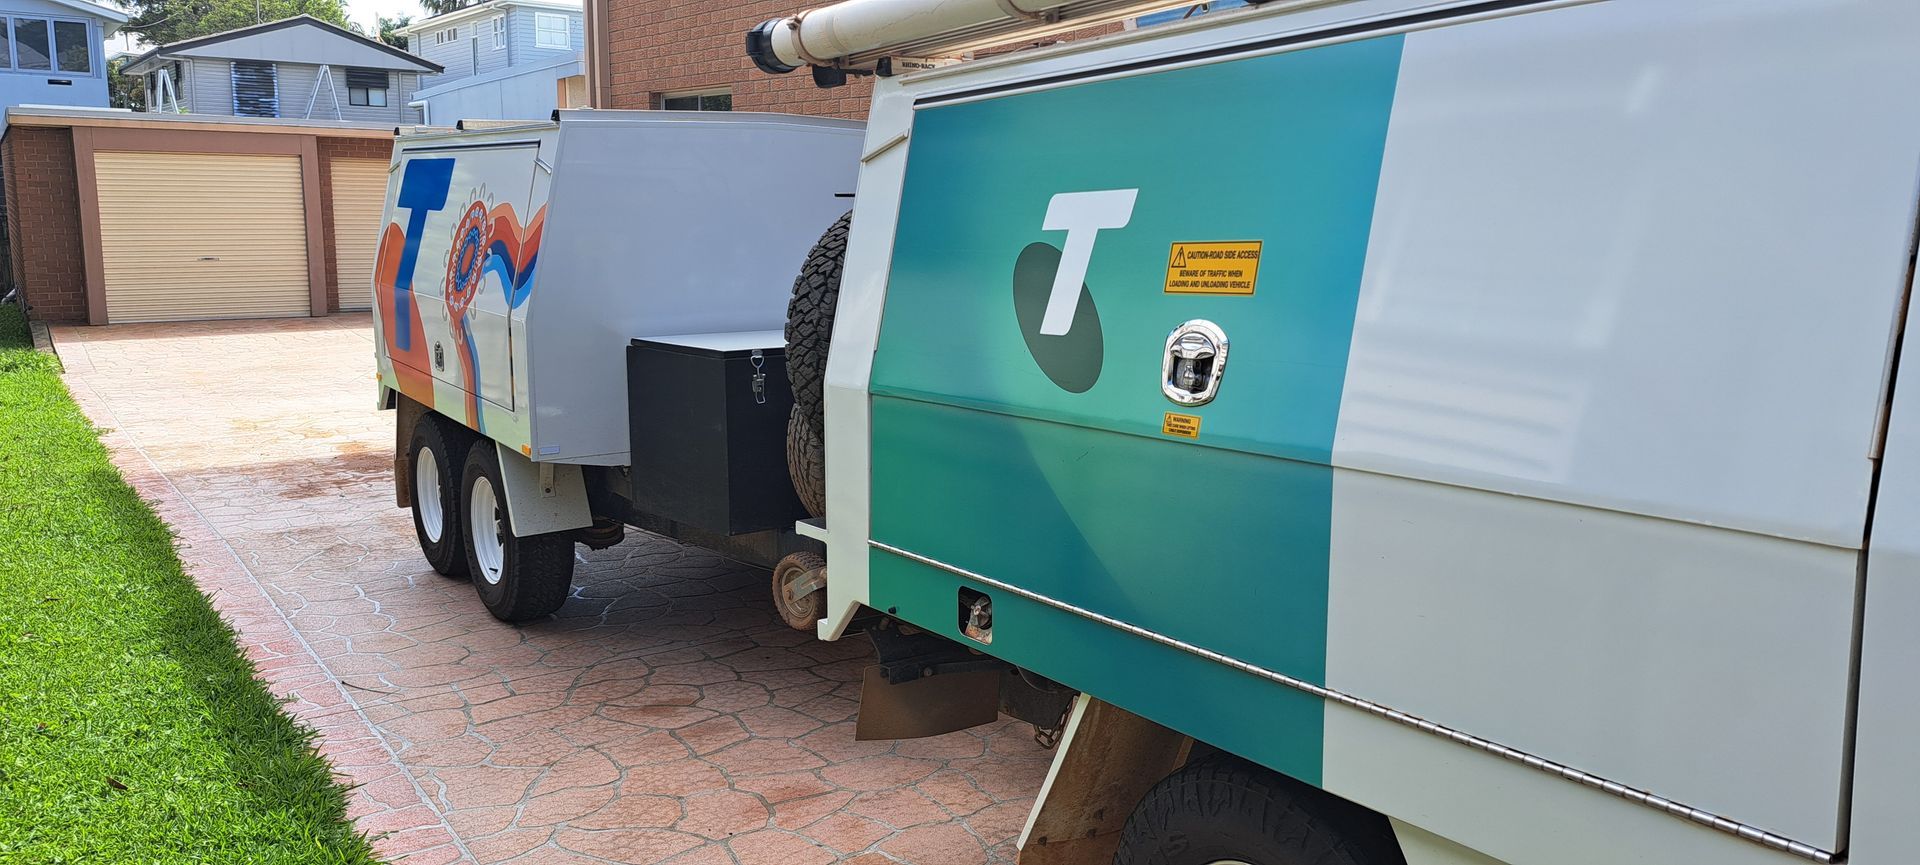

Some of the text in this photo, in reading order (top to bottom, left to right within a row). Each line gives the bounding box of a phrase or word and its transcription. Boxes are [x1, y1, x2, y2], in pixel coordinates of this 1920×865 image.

[394, 158, 456, 352] T
[1224, 250, 1237, 259] SIDE
[1237, 250, 1260, 259] ACCESS
[1039, 188, 1139, 336] T
[1179, 269, 1199, 277] BEWARE
[1229, 281, 1251, 289] VEHICLE
